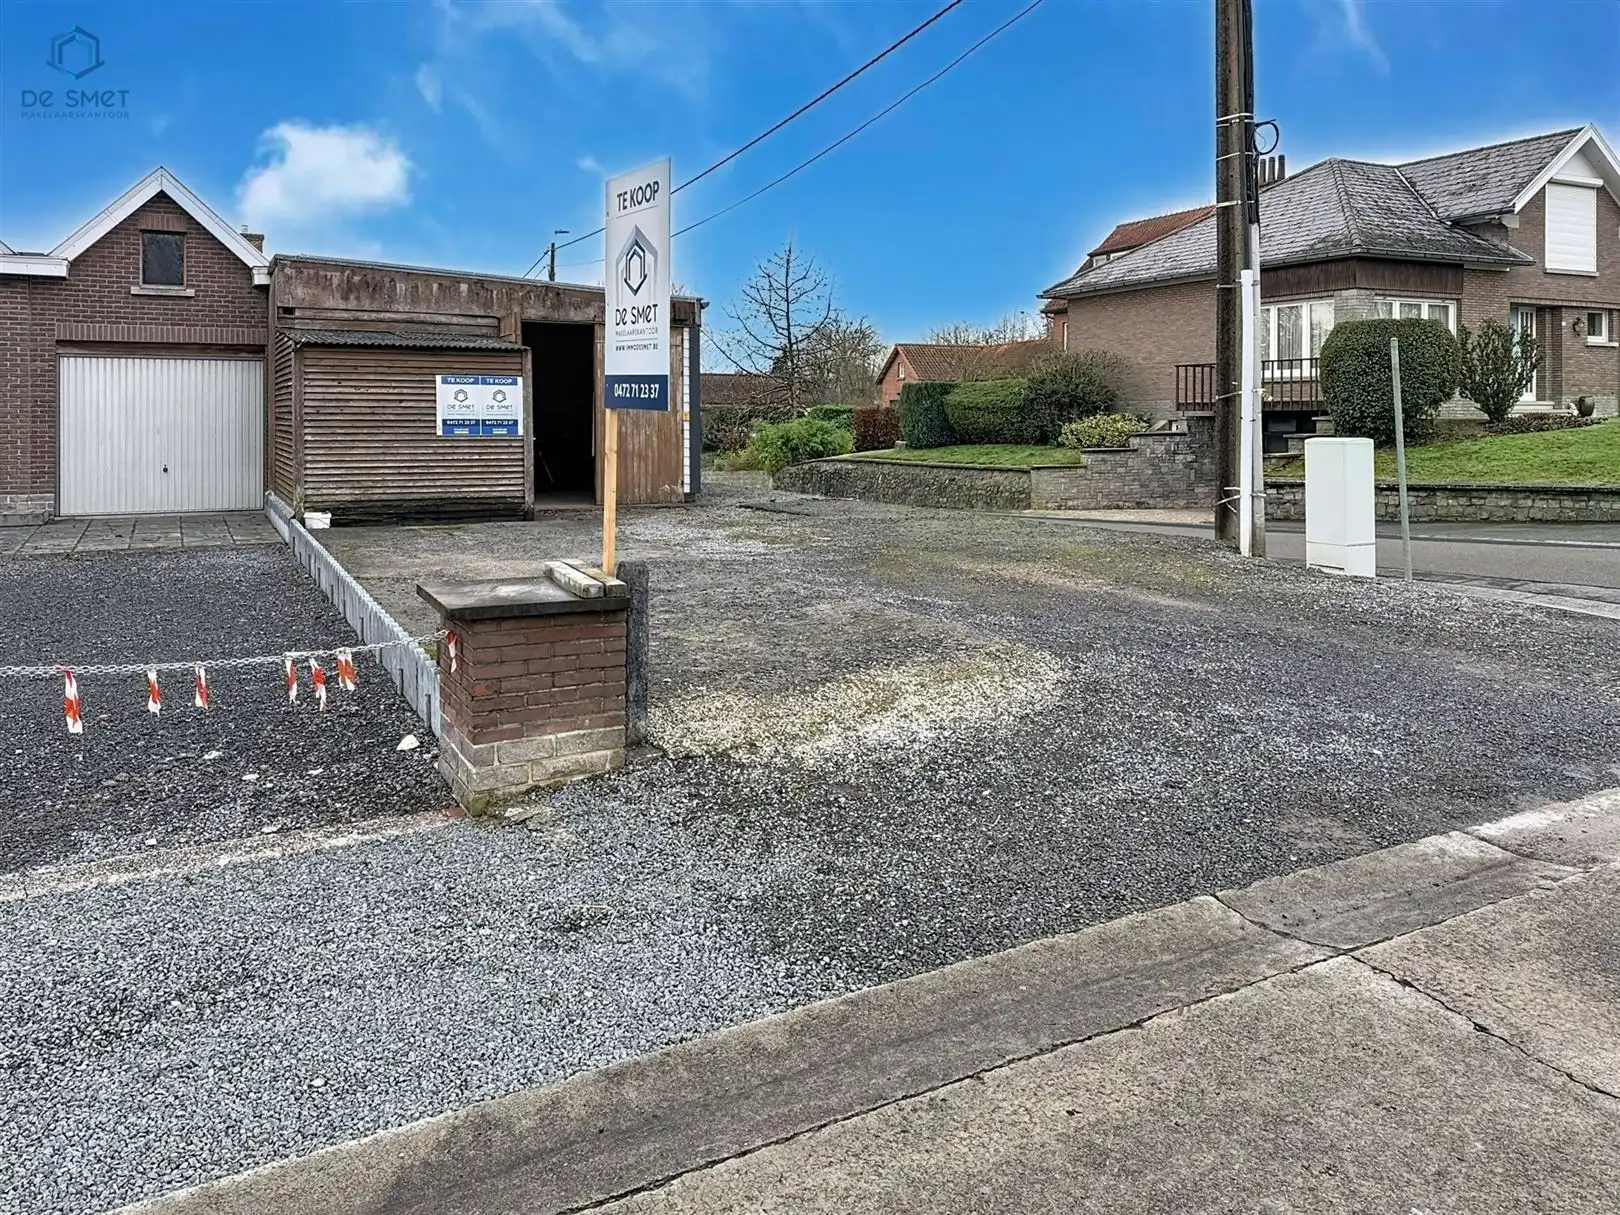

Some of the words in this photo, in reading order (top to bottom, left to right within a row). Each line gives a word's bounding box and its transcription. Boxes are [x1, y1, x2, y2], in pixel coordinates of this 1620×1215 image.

[617, 191, 628, 212] TE
[630, 180, 659, 208] KOOP
[615, 343, 659, 351] WWW.IMMODESMET.BE
[614, 384, 630, 397] 0472
[631, 384, 639, 398] 71
[640, 384, 649, 398] 23
[650, 383, 659, 399] 37
